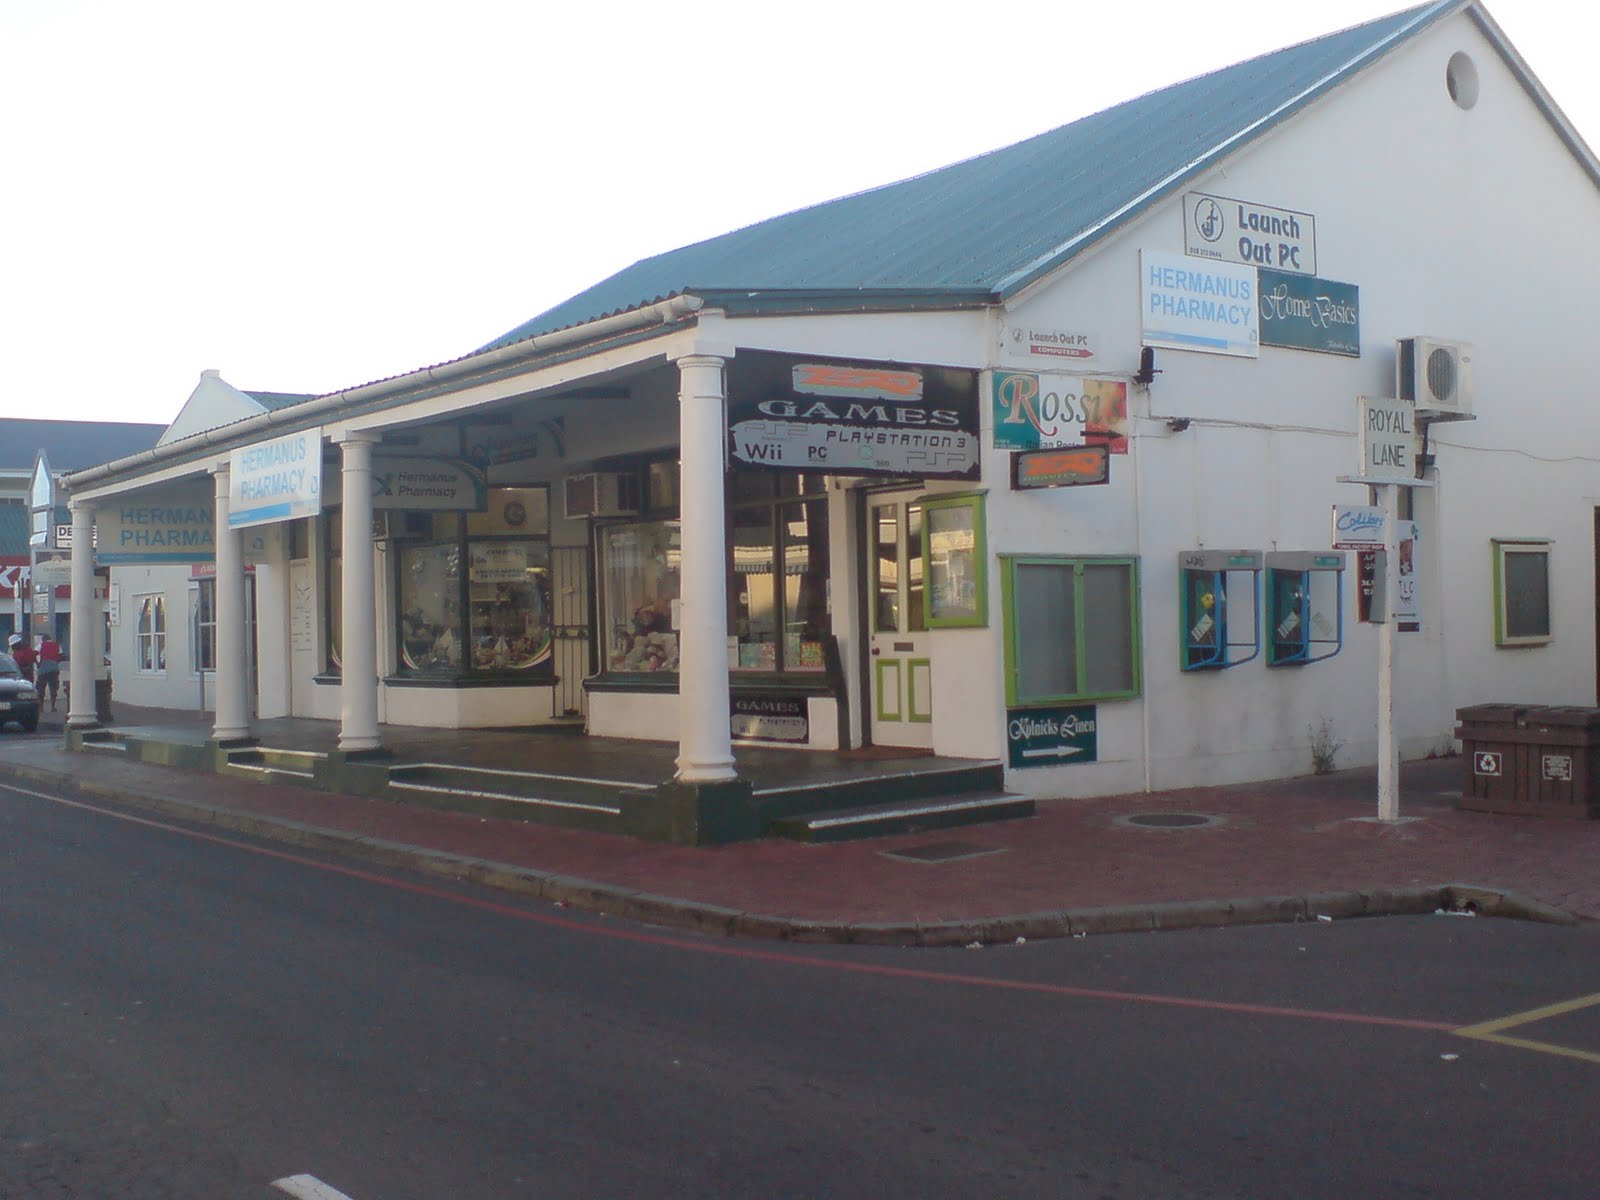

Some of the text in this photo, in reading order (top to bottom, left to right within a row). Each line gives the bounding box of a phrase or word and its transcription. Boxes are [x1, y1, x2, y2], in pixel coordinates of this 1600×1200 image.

[1238, 204, 1300, 239] Launch
[1239, 236, 1300, 269] Out PC
[1150, 265, 1250, 300] HERMANUS
[1150, 293, 1250, 326] PHARMACY
[1261, 283, 1357, 328] Home Basics
[1029, 330, 1088, 346] Launch Out PC
[1037, 346, 1080, 356] COMPUTERS
[758, 399, 960, 426] GAMES
[1368, 408, 1411, 434] ROYAL
[826, 430, 966, 448] PLAYSTATION 3
[241, 437, 306, 474] HERMANUS
[744, 443, 783, 460] Wii
[808, 445, 828, 459] PC
[906, 450, 967, 466] PSP
[1372, 443, 1406, 468] LANE
[240, 467, 305, 502] PHARMACY
[398, 470, 458, 482] Hermanus
[398, 485, 457, 499] Pharmacy
[120, 507, 214, 525] HERMAN
[120, 528, 215, 547] PHARMA
[735, 700, 801, 712] GAMES
